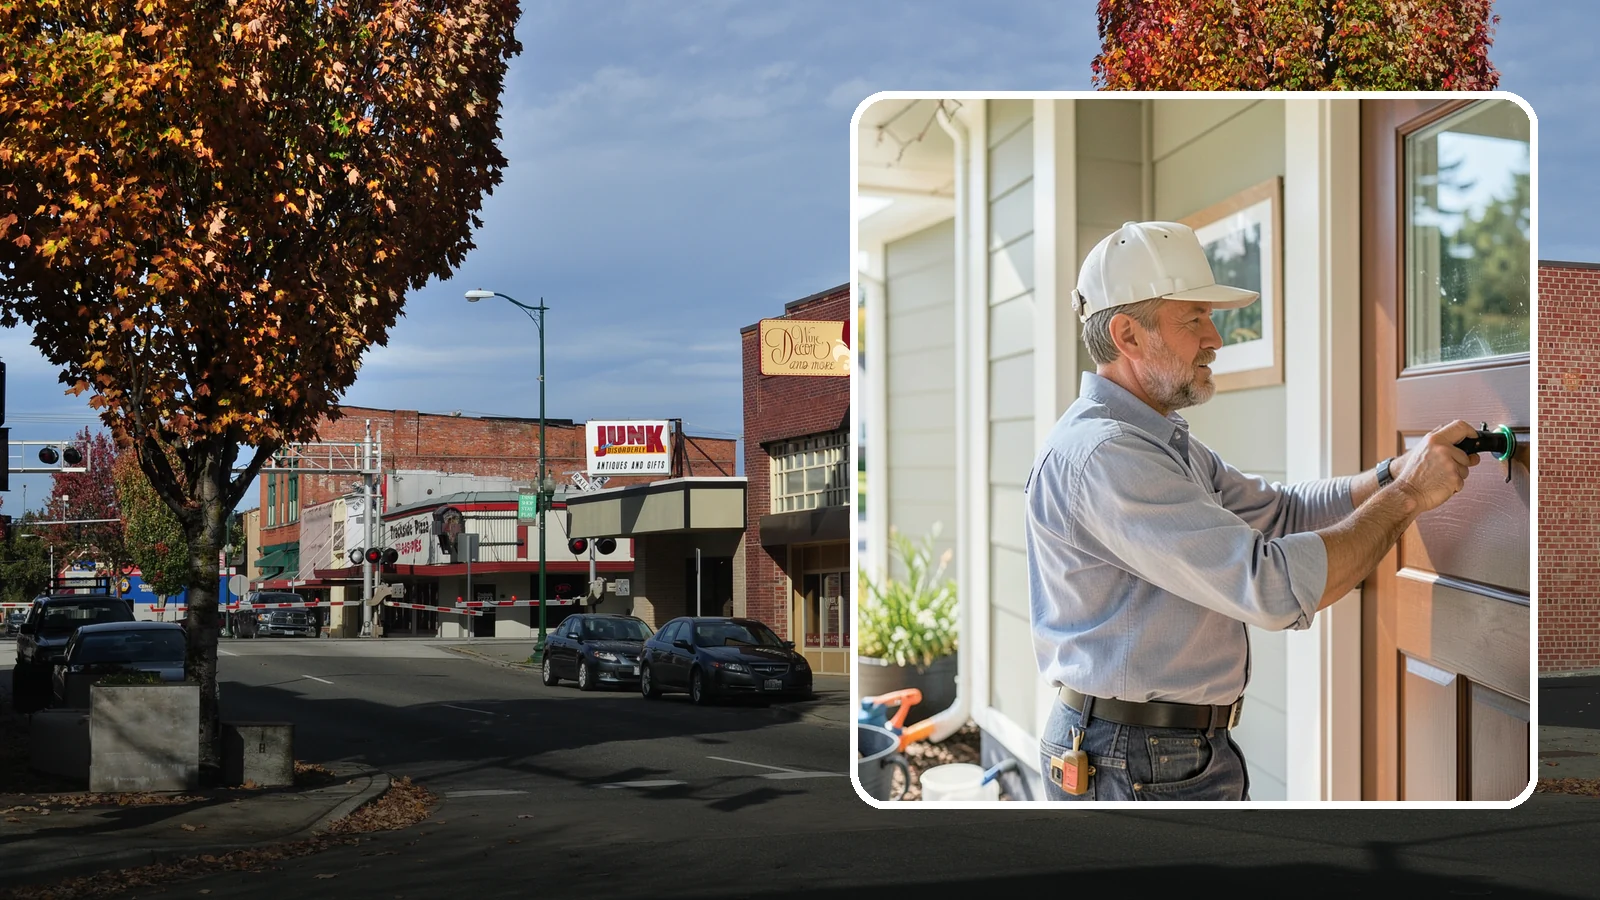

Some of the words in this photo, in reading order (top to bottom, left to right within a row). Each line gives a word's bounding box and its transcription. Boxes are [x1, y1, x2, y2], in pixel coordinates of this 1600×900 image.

[596, 425, 665, 457] JUNK
[607, 446, 646, 454] DISORDERLY
[597, 461, 628, 470] ANTIQUES
[631, 461, 644, 470] AND
[647, 460, 666, 470] GIFTS
[414, 519, 429, 535] Pizza
